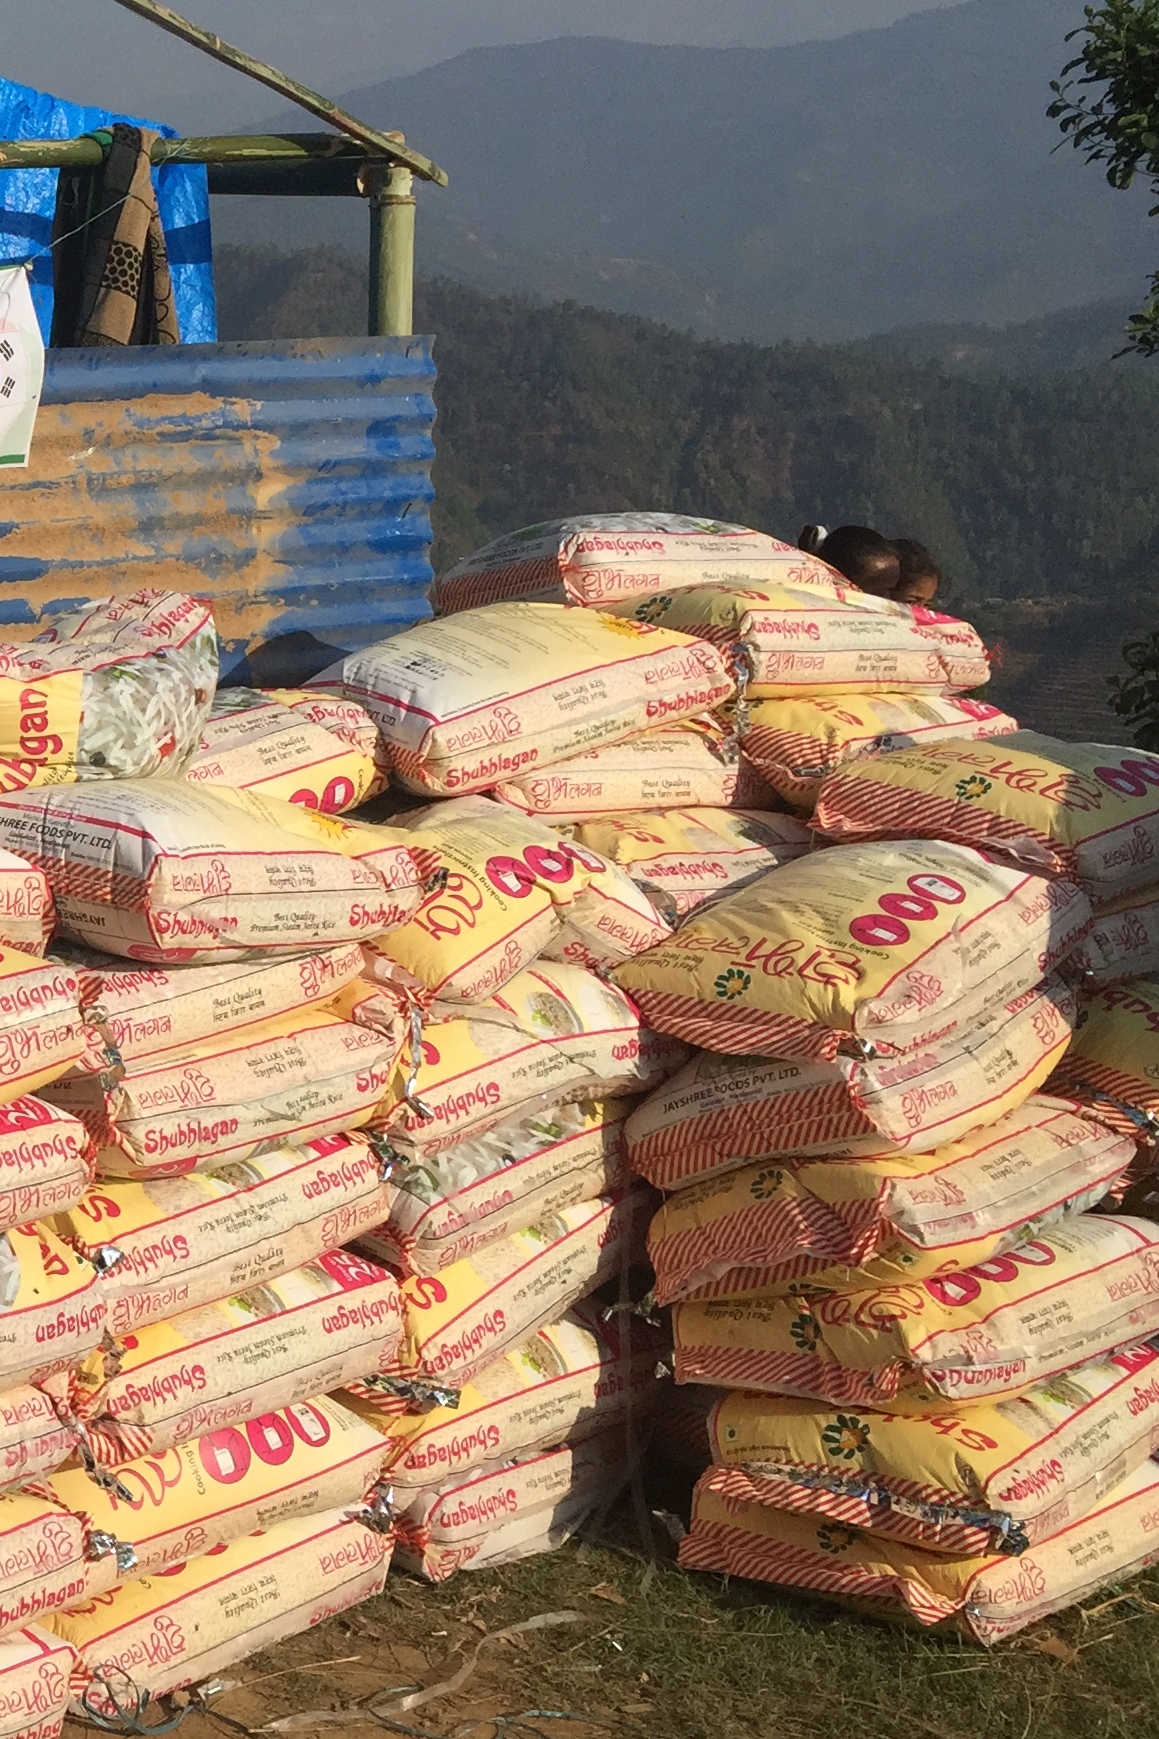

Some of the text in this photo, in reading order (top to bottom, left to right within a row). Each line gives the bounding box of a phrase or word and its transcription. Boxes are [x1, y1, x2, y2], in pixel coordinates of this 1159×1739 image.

[645, 681, 731, 718] Shubhlagan
[447, 707, 522, 751] शुभलगन
[445, 748, 539, 787] Shubhlagan
[530, 777, 603, 808] शुभलगन
[28, 823, 64, 840] FOODS
[65, 832, 89, 845] PVT.
[89, 835, 112, 850] LTD.
[172, 859, 232, 894] शुभलगन
[233, 987, 263, 1004] Quality
[140, 1067, 215, 1109] शुभलगन
[662, 1086, 713, 1114] JAYSHREE
[779, 1066, 801, 1081] LTD.
[144, 1117, 239, 1155] Shubhlagan
[424, 1308, 506, 1375] Shubhlagan
[106, 1364, 207, 1416] Shubhlagan
[404, 1424, 500, 1471] Shubhlagan
[188, 1449, 207, 1497] Cooking
[440, 1488, 517, 1529] Shubhlagan
[224, 1588, 281, 1619] Best Quality
[100, 1615, 186, 1676] शुभलगन
